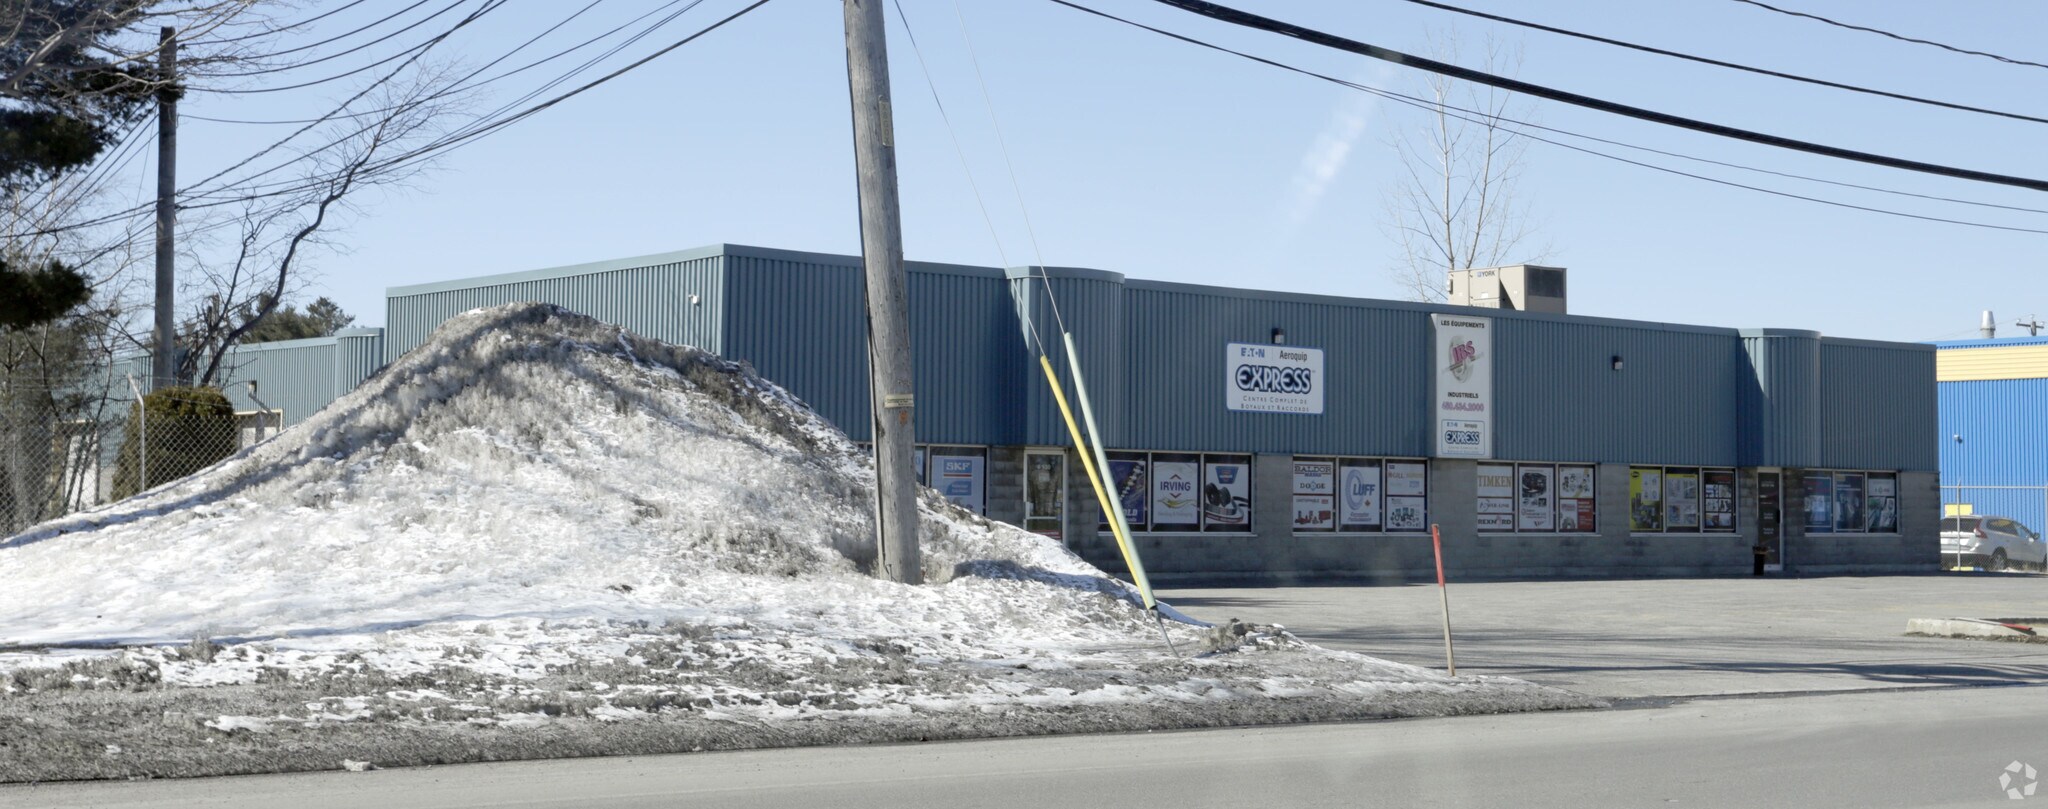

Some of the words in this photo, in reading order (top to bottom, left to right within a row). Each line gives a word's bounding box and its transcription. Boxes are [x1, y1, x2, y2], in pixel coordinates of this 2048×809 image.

[1280, 350, 1307, 362] Aeroquip
[1235, 364, 1311, 394] EXPRESS
[1445, 430, 1480, 445] EXPRESS
[946, 462, 970, 470] SKF
[1294, 465, 1331, 473] BALDOR
[1160, 481, 1191, 491] IRVING
[1478, 475, 1512, 488] TIMKEN
[1353, 484, 1376, 496] LUFF
